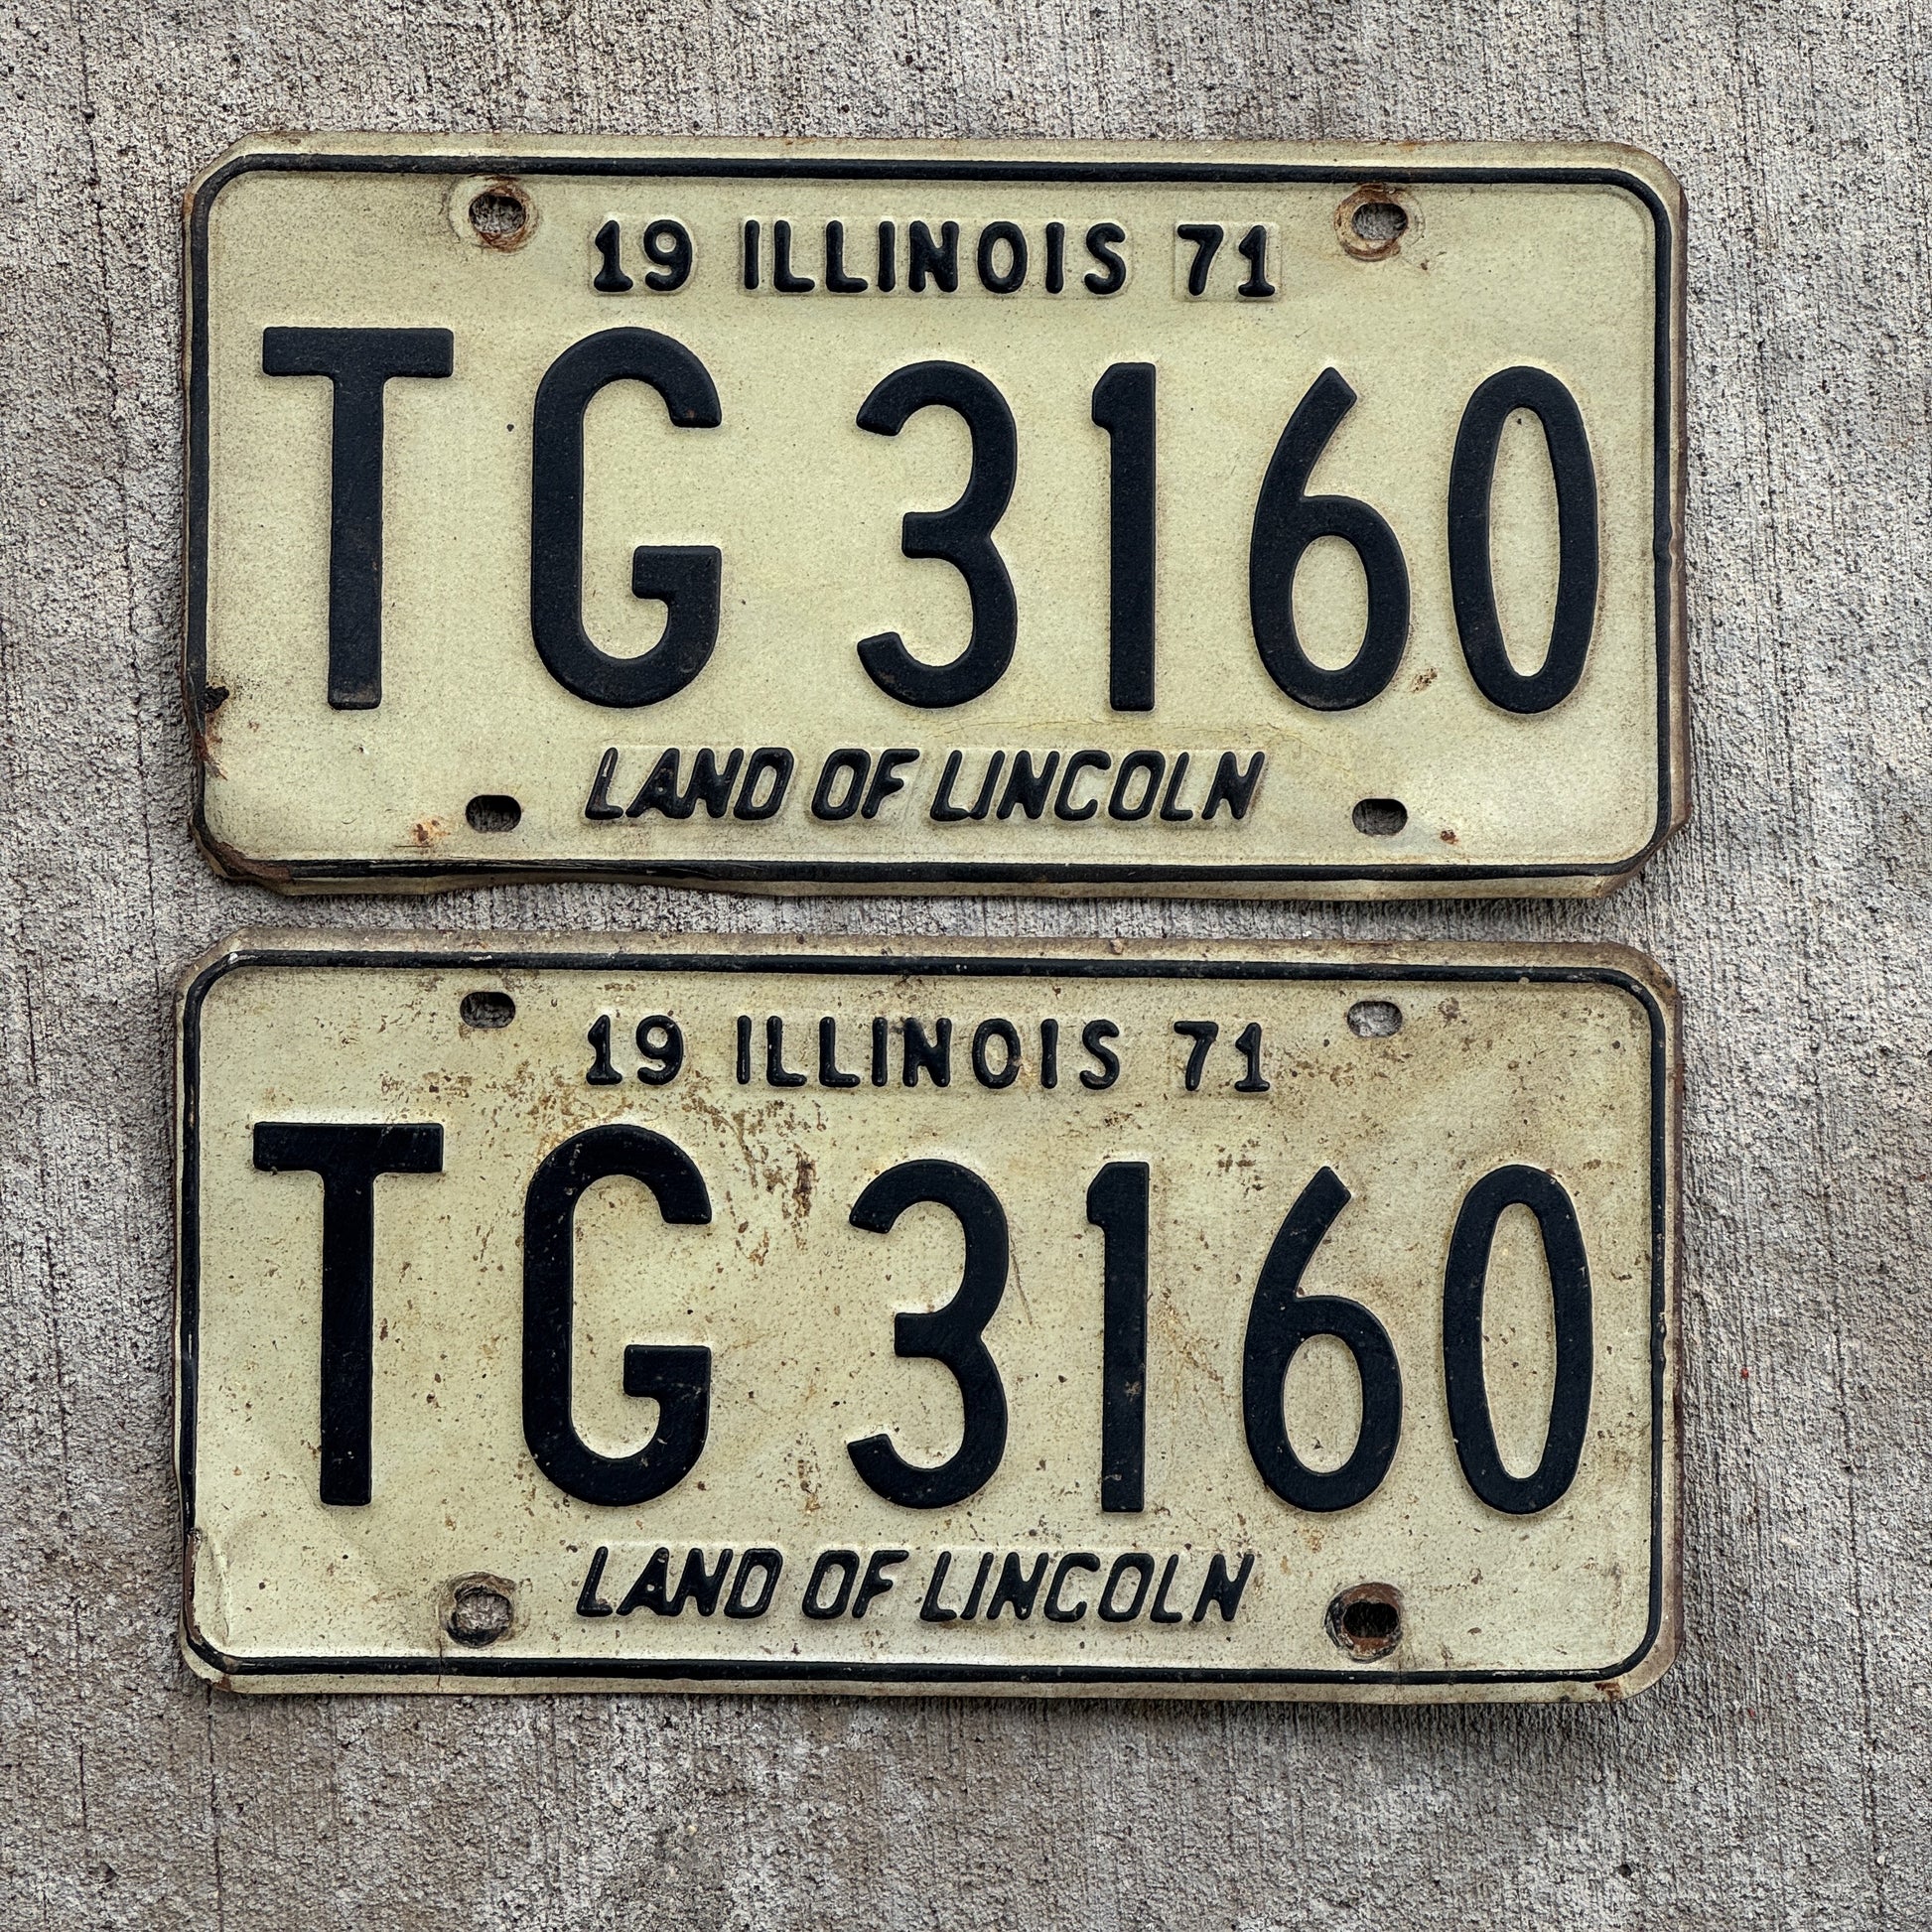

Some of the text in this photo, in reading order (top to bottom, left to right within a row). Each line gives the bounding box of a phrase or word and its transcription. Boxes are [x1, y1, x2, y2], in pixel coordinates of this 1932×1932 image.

[594, 220, 1276, 297] 19 ILLINOIS 71
[262, 327, 1598, 714] TG 3160
[585, 748, 1266, 822] LAND OF LINCOLN
[586, 1015, 1271, 1093] 19 ILLINOIS 71
[253, 1122, 1592, 1515] TG 3160
[576, 1547, 1255, 1623] LAND OF LINCOLN
